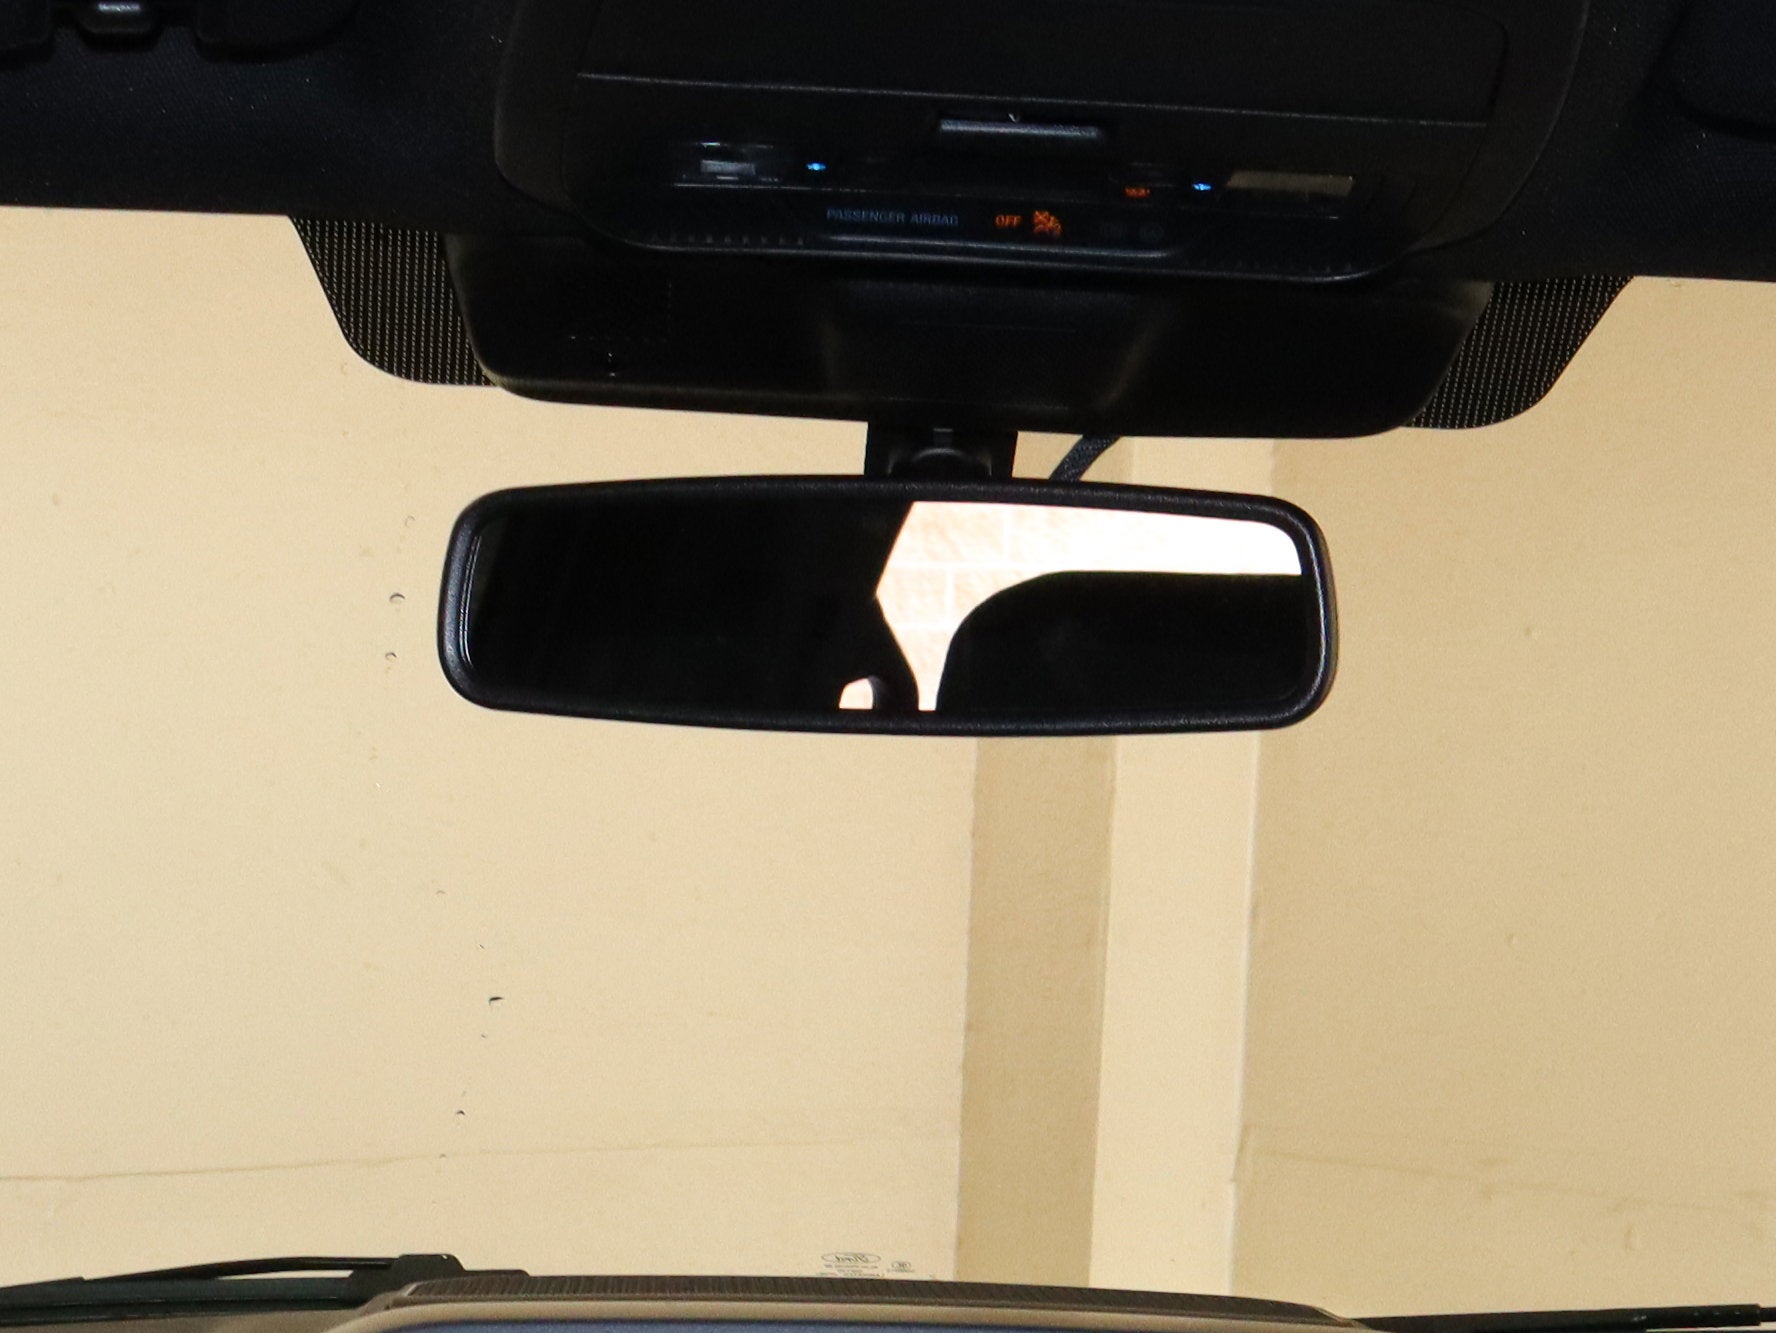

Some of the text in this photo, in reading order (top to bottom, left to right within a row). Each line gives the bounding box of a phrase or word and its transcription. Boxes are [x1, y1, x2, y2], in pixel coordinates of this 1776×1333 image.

[826, 208, 1023, 228] PASSENGER AIRBAG OFF
